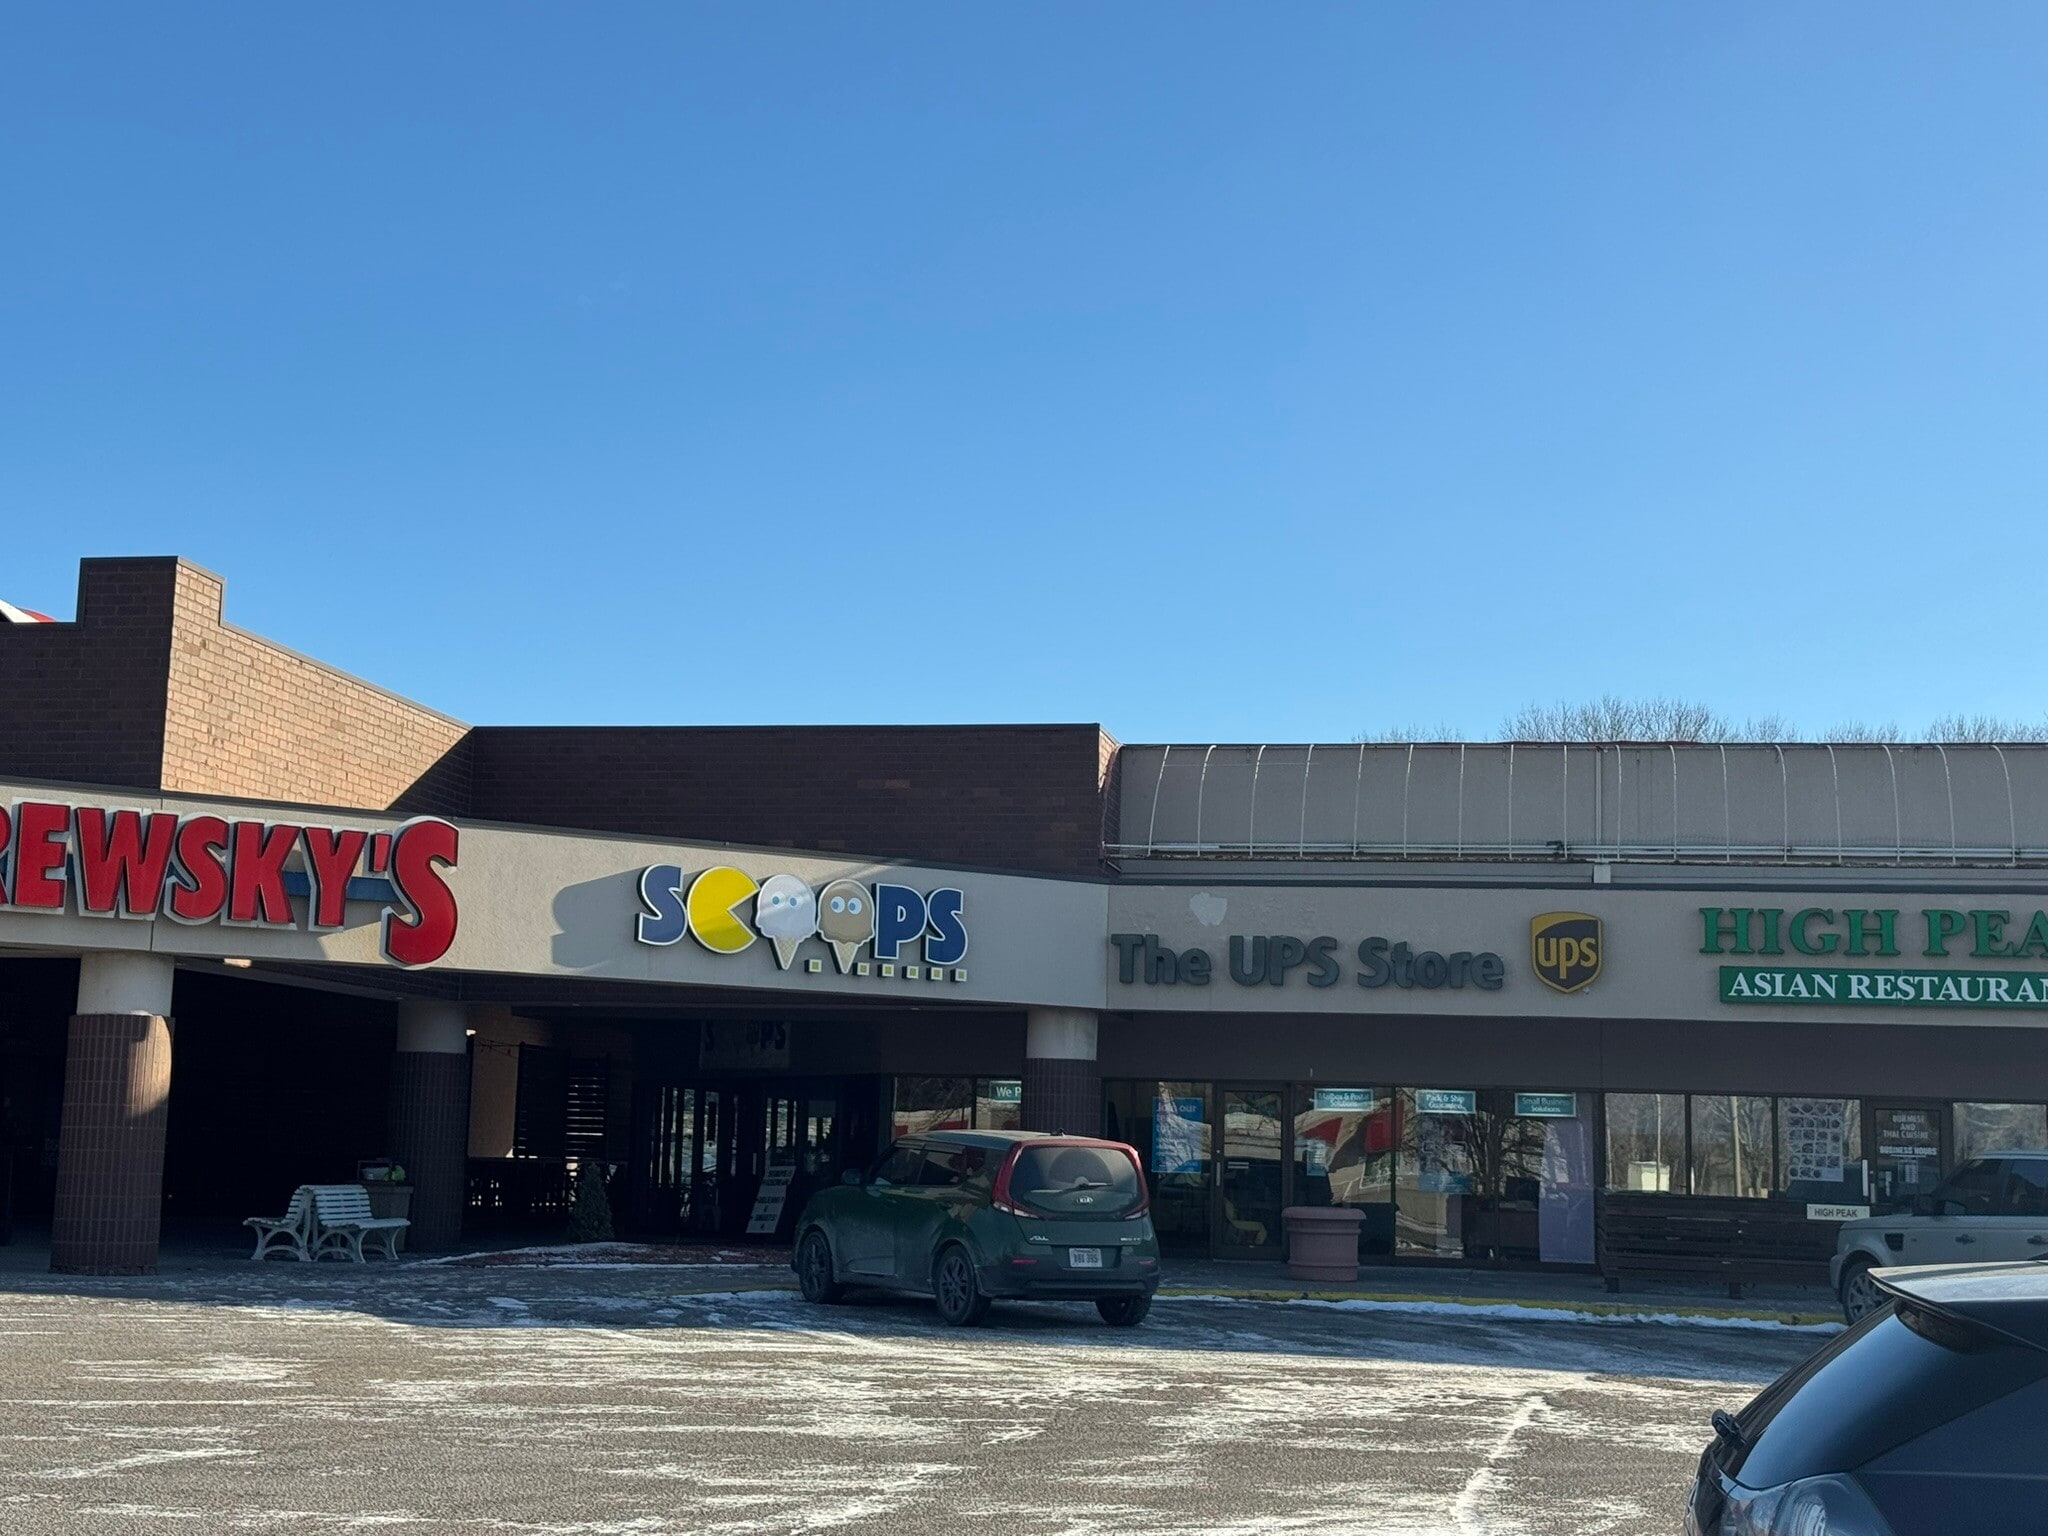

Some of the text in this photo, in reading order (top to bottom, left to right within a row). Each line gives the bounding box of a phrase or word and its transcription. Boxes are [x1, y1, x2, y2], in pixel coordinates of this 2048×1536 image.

[0, 800, 459, 967] EWSKY'S
[1699, 907, 2048, 958] HIGH PEA
[1110, 933, 1506, 990] The UPS Store
[1537, 935, 1597, 979] ups
[1728, 972, 1838, 999] ASIAN
[996, 1086, 1012, 1098] We
[1179, 1104, 1197, 1112] our
[1900, 1123, 1916, 1131] AND
[1883, 1130, 1899, 1138] THAI
[1914, 1147, 1938, 1156] HOURS
[1814, 1208, 1858, 1219] HIGH PEAK
